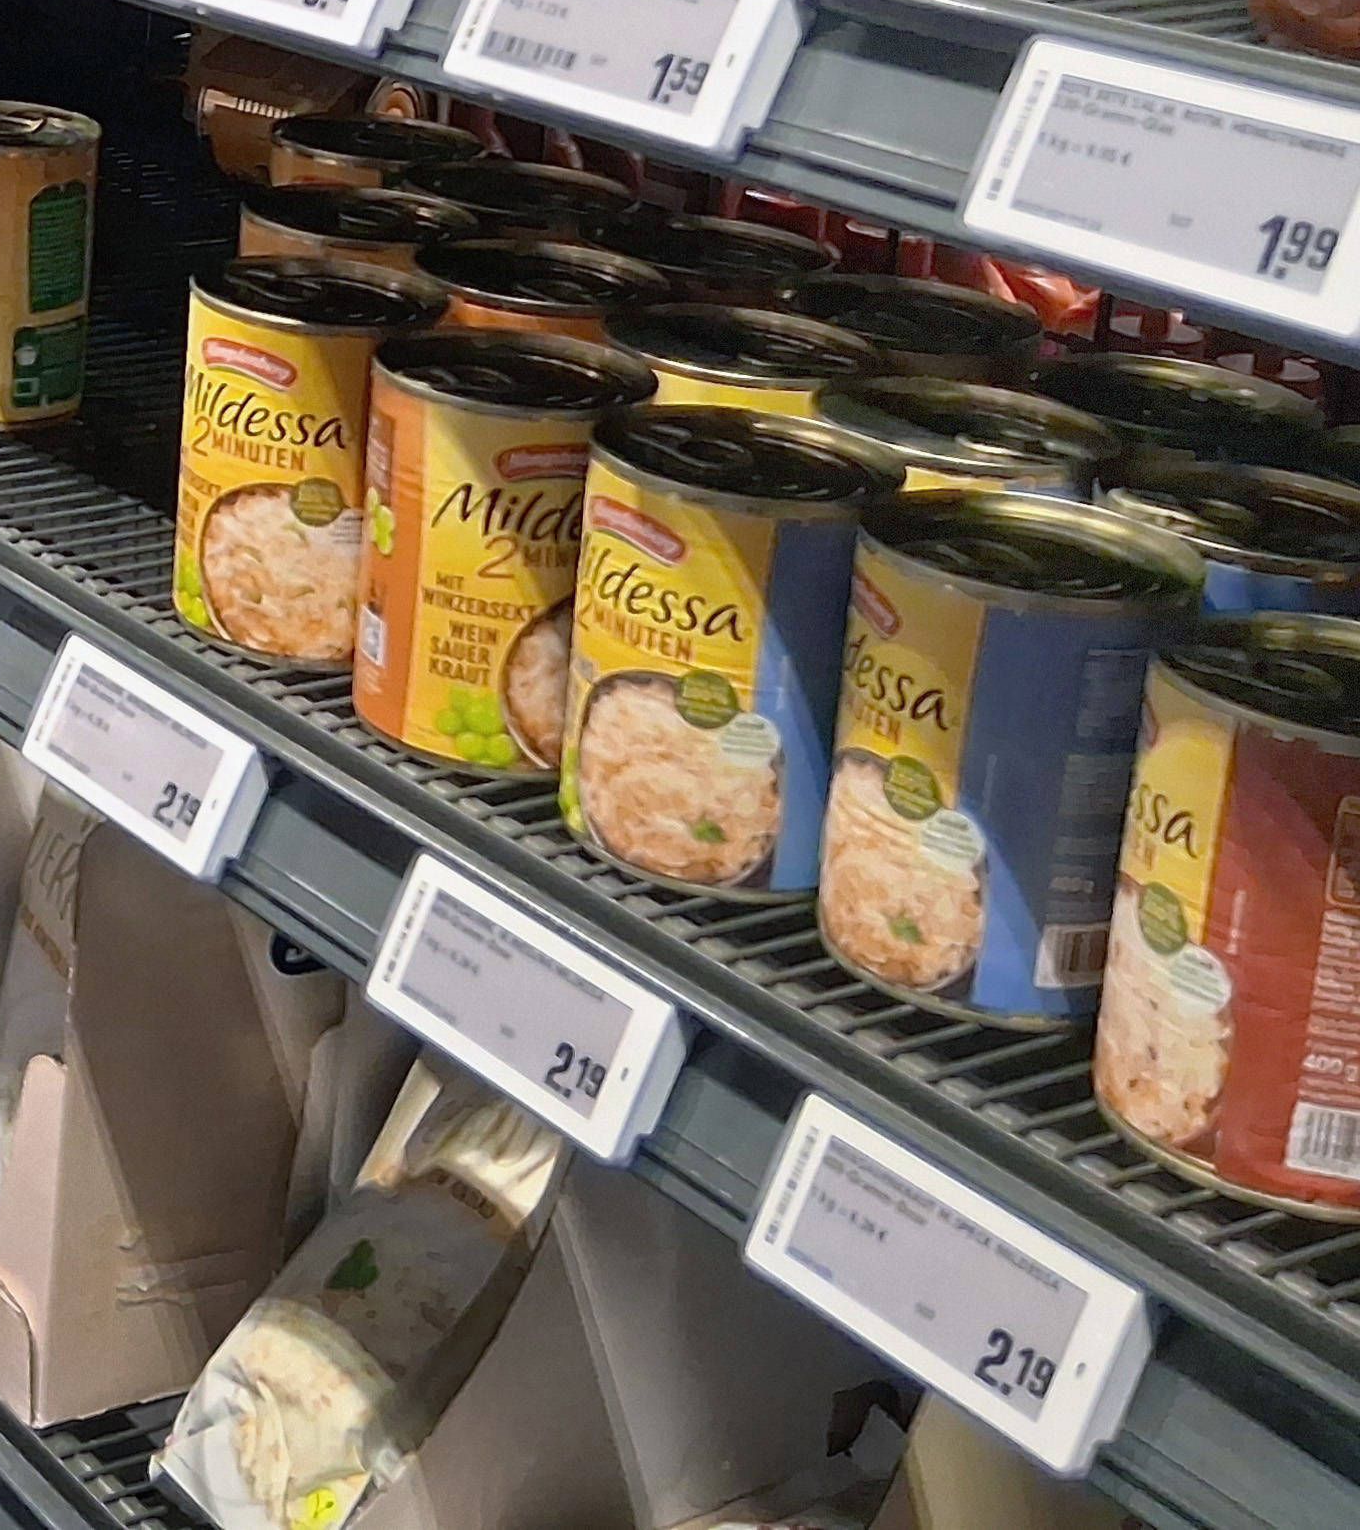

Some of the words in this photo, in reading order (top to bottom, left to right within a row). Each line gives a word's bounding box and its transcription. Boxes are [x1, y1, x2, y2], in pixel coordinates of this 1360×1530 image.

[647, 52, 712, 104] 1.59
[1255, 214, 1341, 281] 1.99
[191, 415, 212, 457] 2
[210, 429, 307, 472] MINUTEN
[435, 570, 465, 591] MIT
[477, 533, 519, 579] 2
[430, 635, 491, 666] SAUER
[449, 619, 501, 645] WEIN
[152, 781, 203, 829] 2.19
[543, 1041, 608, 1099] 2.19
[973, 1327, 1057, 1401] 2.19
